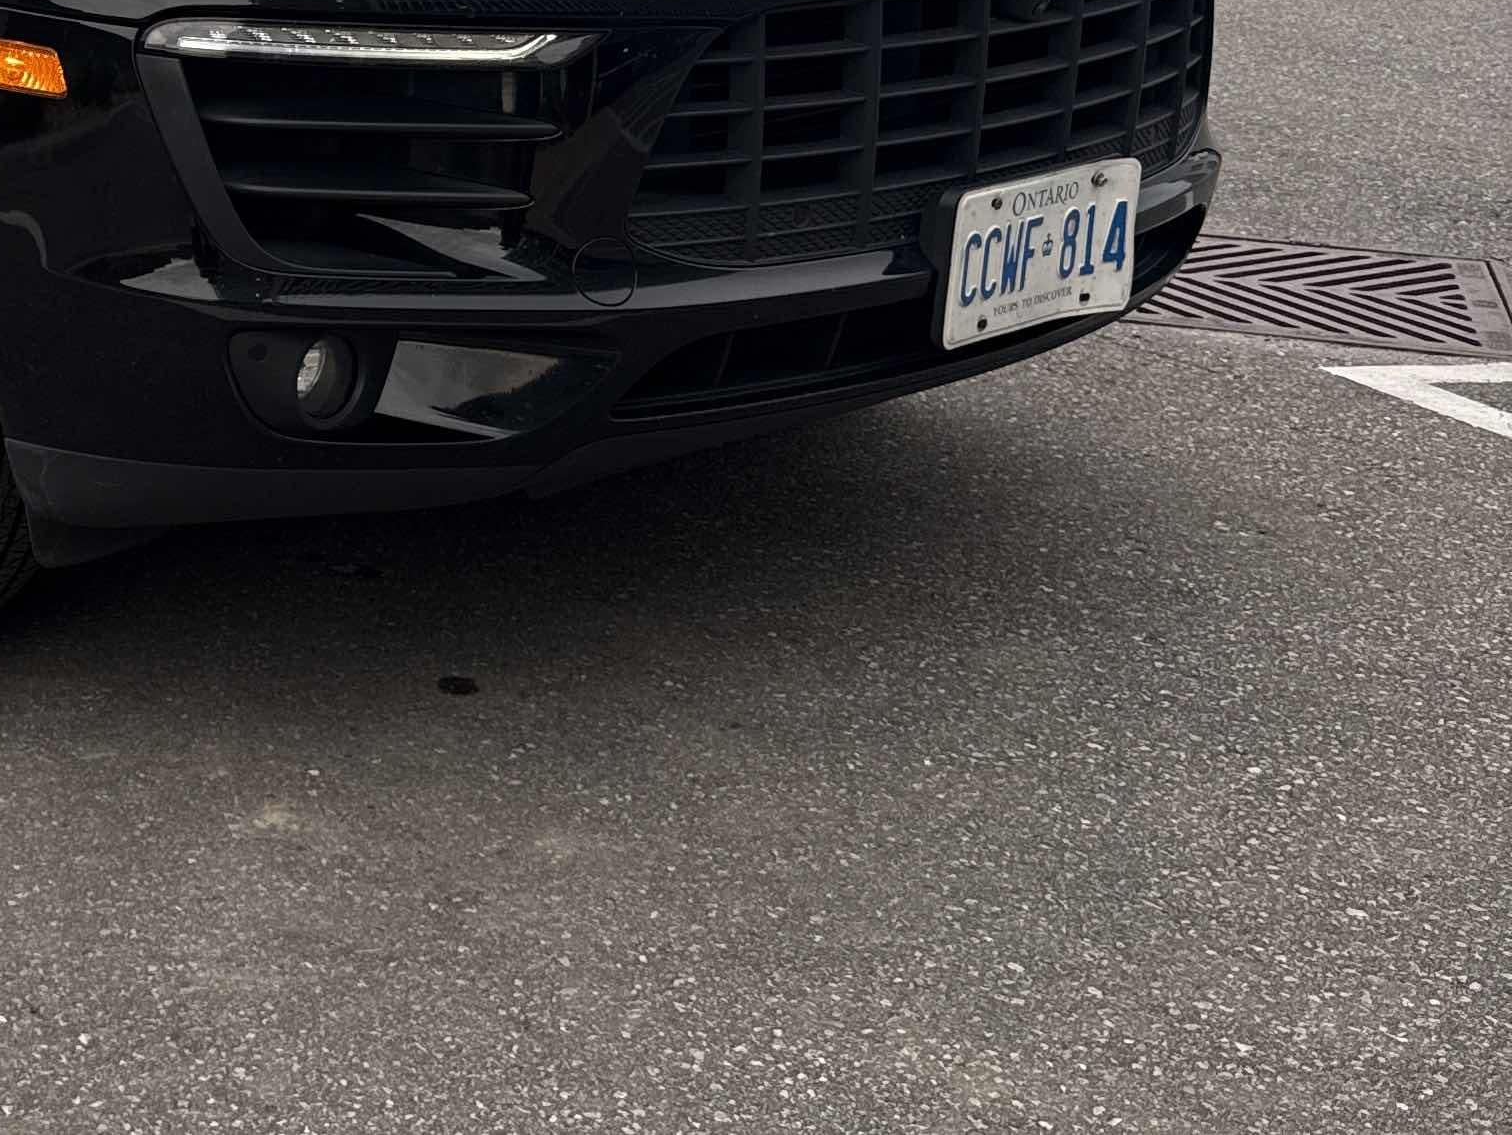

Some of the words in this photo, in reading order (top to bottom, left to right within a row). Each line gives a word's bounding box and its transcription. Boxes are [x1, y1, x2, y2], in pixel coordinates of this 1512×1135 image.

[1013, 182, 1079, 215] ONTARIO
[961, 217, 1044, 306] CCWF
[1059, 200, 1128, 278] 814
[1021, 297, 1033, 308] TO
[1033, 286, 1073, 304] DISCOVER
